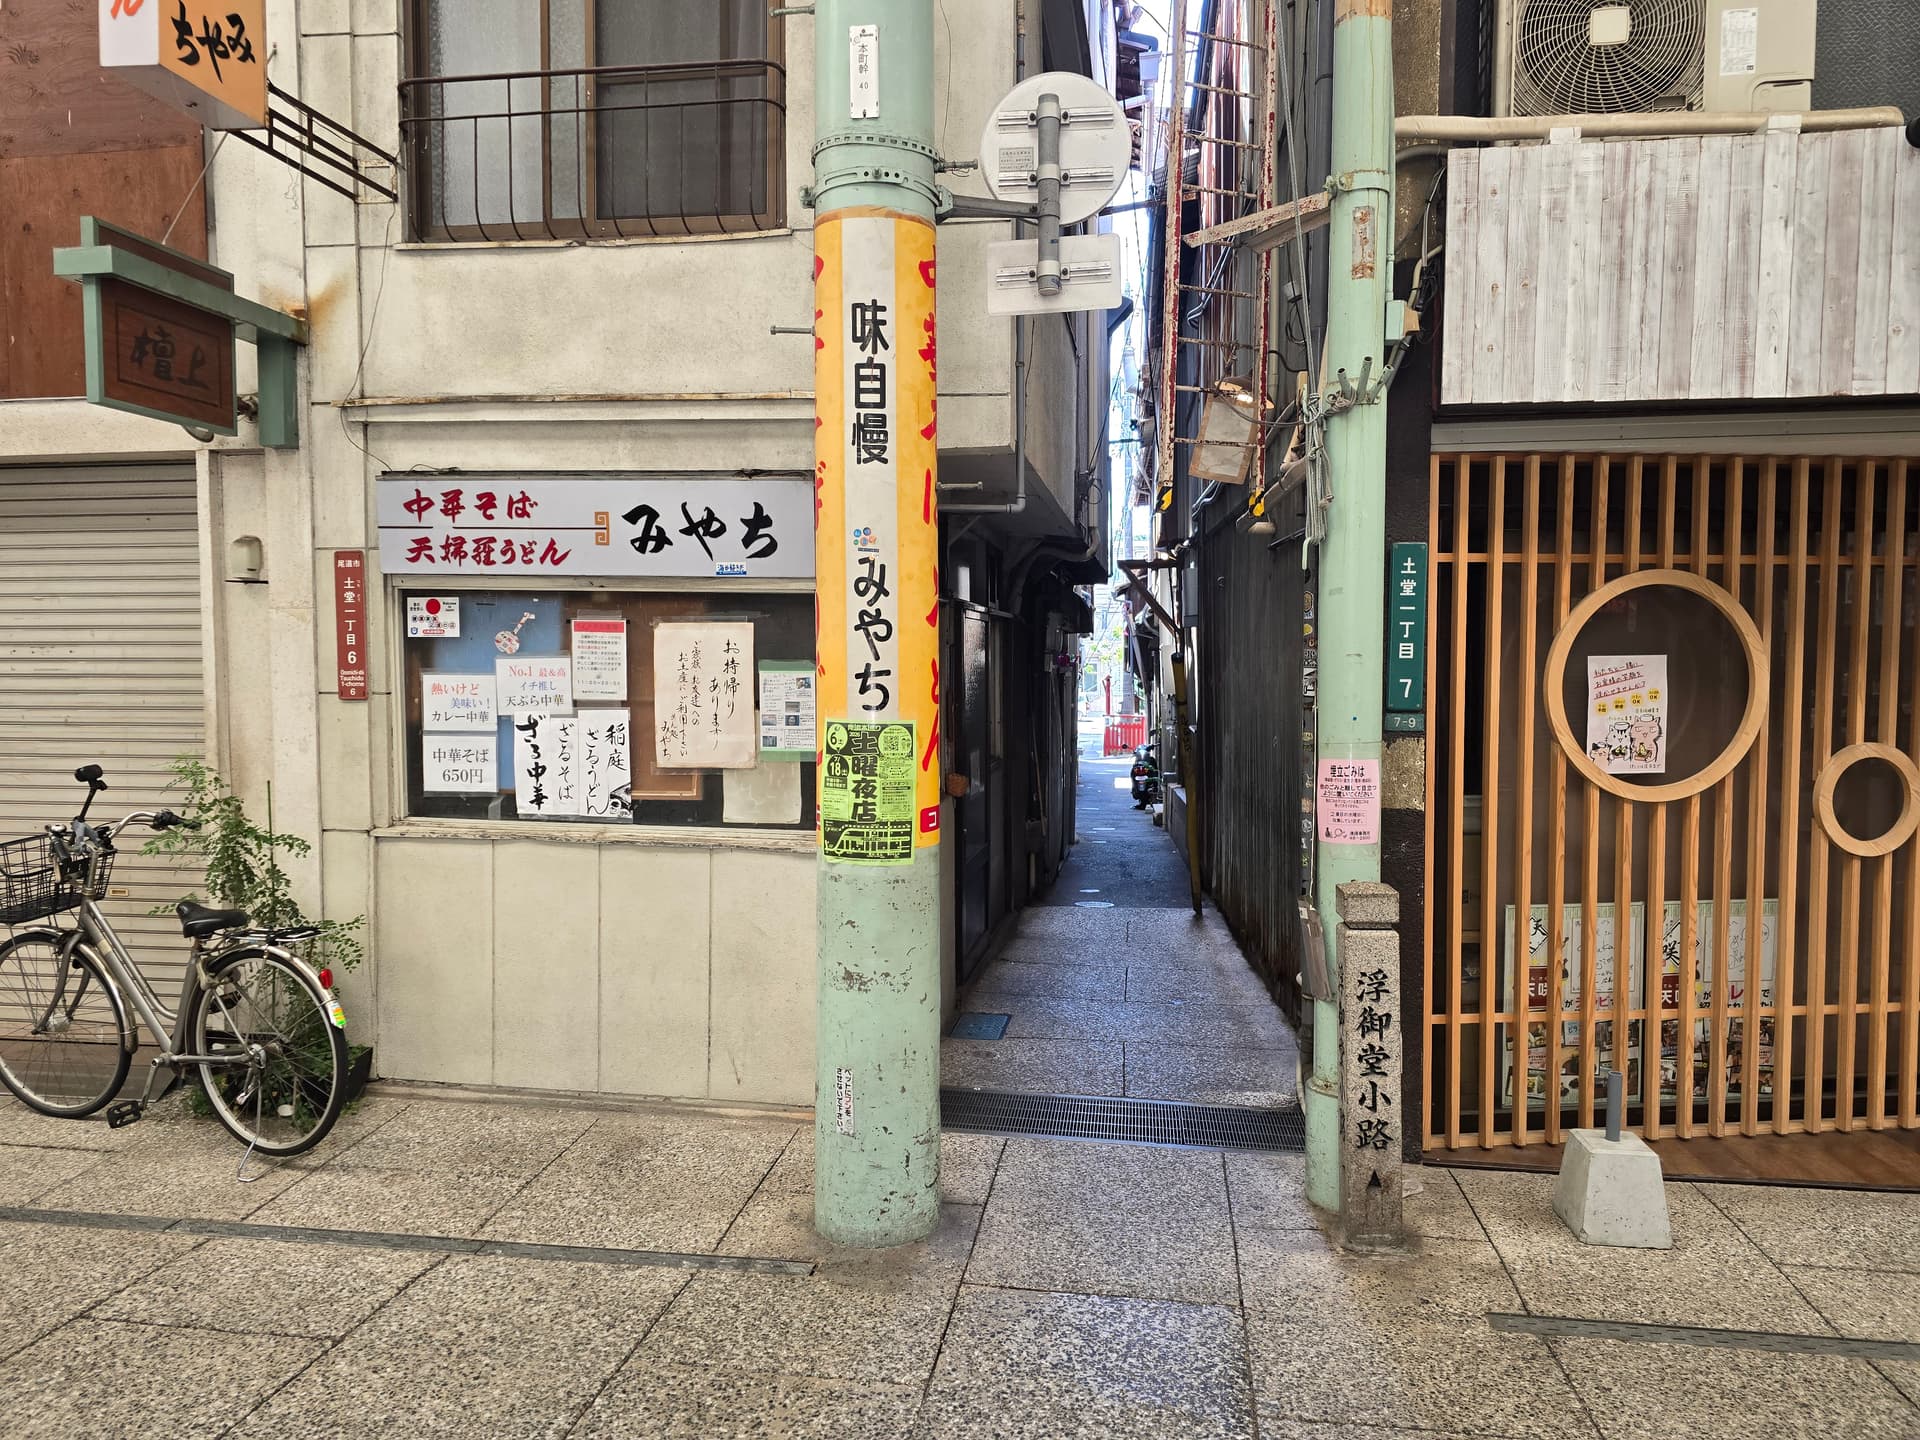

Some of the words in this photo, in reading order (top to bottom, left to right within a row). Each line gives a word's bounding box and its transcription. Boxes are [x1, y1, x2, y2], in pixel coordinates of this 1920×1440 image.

[859, 81, 869, 89] 40
[851, 298, 890, 465] 味自慢
[402, 488, 539, 523] 中華そば
[621, 501, 778, 562] みやち
[337, 559, 360, 568] 尾道市
[343, 577, 357, 645] 土堂一丁目
[1398, 557, 1417, 659] 土堂一丁目
[854, 556, 893, 711] みやち
[347, 650, 357, 664] 6
[509, 666, 532, 677] No.1
[723, 638, 741, 719] お持帰り
[350, 688, 356, 696] 6
[431, 683, 480, 696] 熱いけど
[521, 681, 557, 691] イチ推し
[1399, 678, 1413, 699] 7
[506, 694, 564, 707] 天ぷら中華
[431, 711, 489, 723] カレー中華
[1393, 717, 1416, 729] 7-9
[433, 748, 489, 763] 中華そば
[605, 723, 627, 772] 稲庭
[559, 723, 575, 800] ざるそば
[586, 728, 610, 815] ざるうどん
[442, 768, 483, 783] 650円
[850, 731, 880, 823] 土曜夜店
[1356, 968, 1394, 1151] 浮御堂小路
